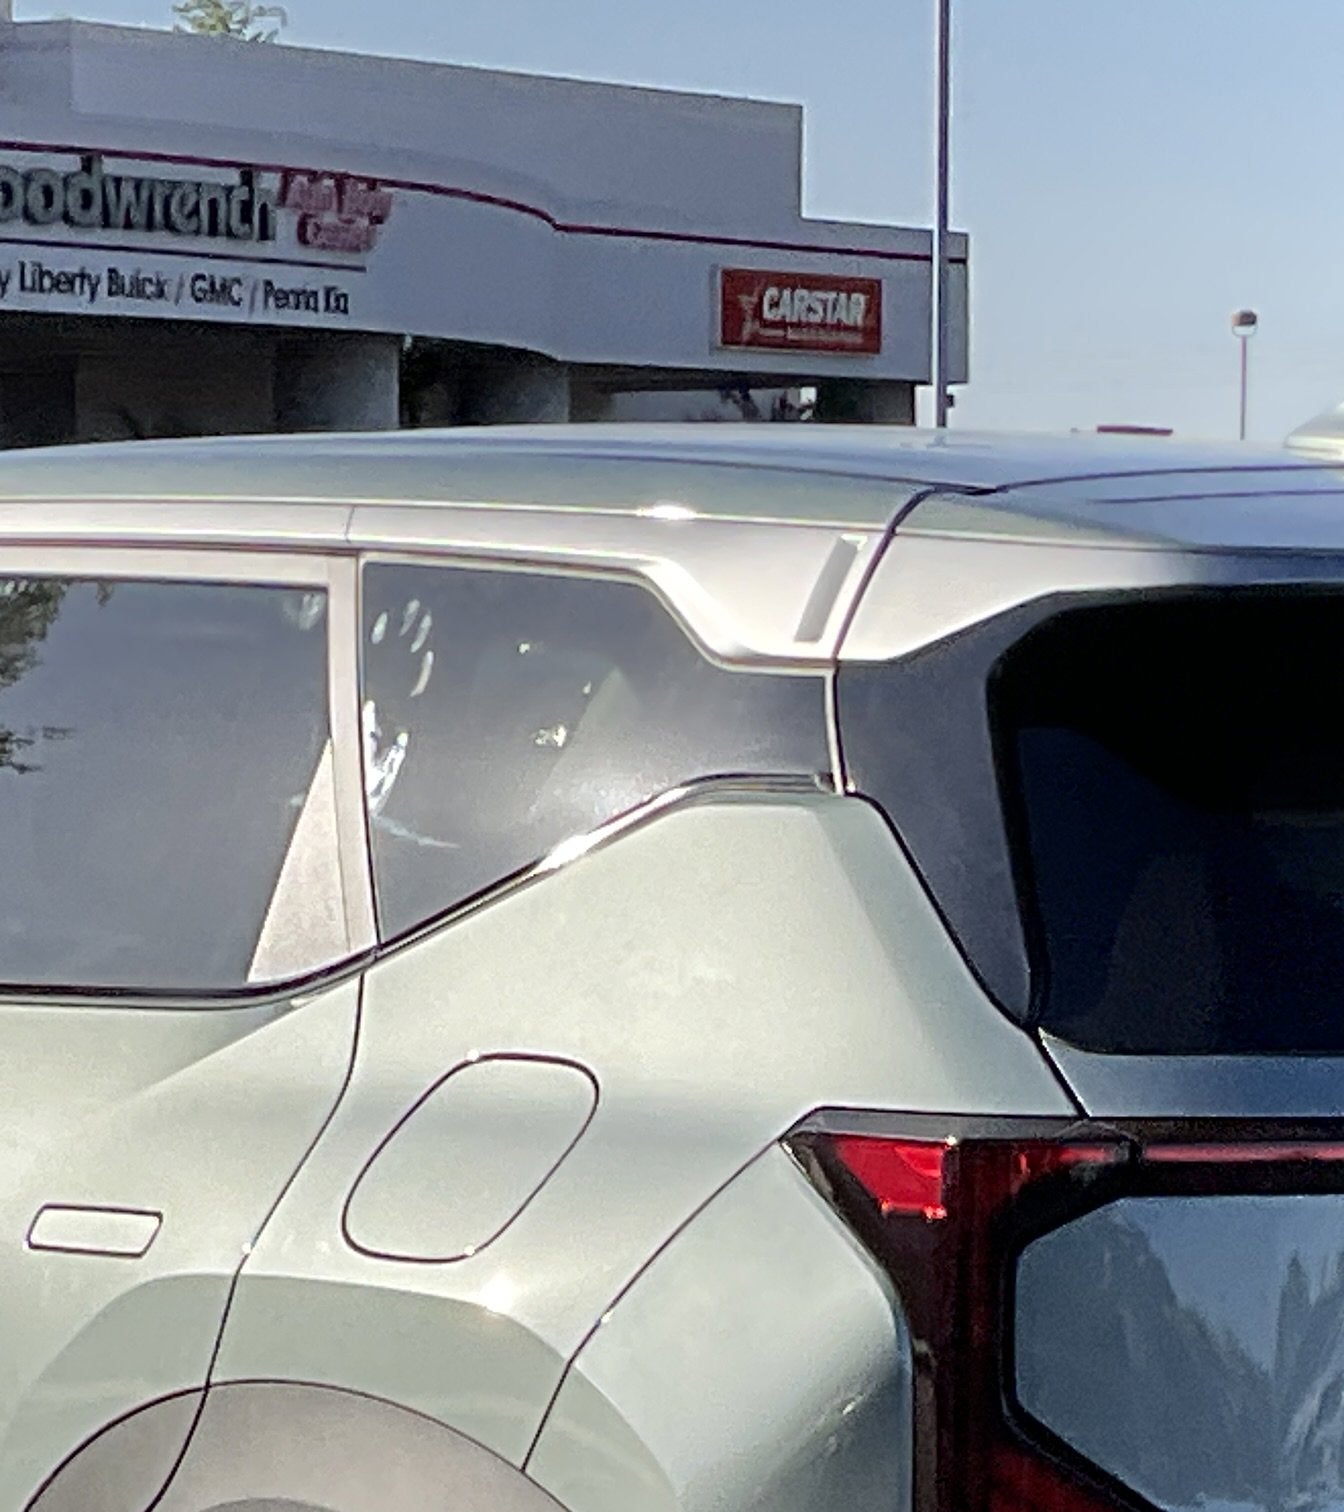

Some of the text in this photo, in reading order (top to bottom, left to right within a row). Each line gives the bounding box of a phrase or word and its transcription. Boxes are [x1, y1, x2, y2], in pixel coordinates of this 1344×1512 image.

[18, 260, 101, 302] Liberty
[107, 268, 169, 302] Buick
[190, 274, 244, 305] GMC
[762, 287, 866, 327] CARSTAR
